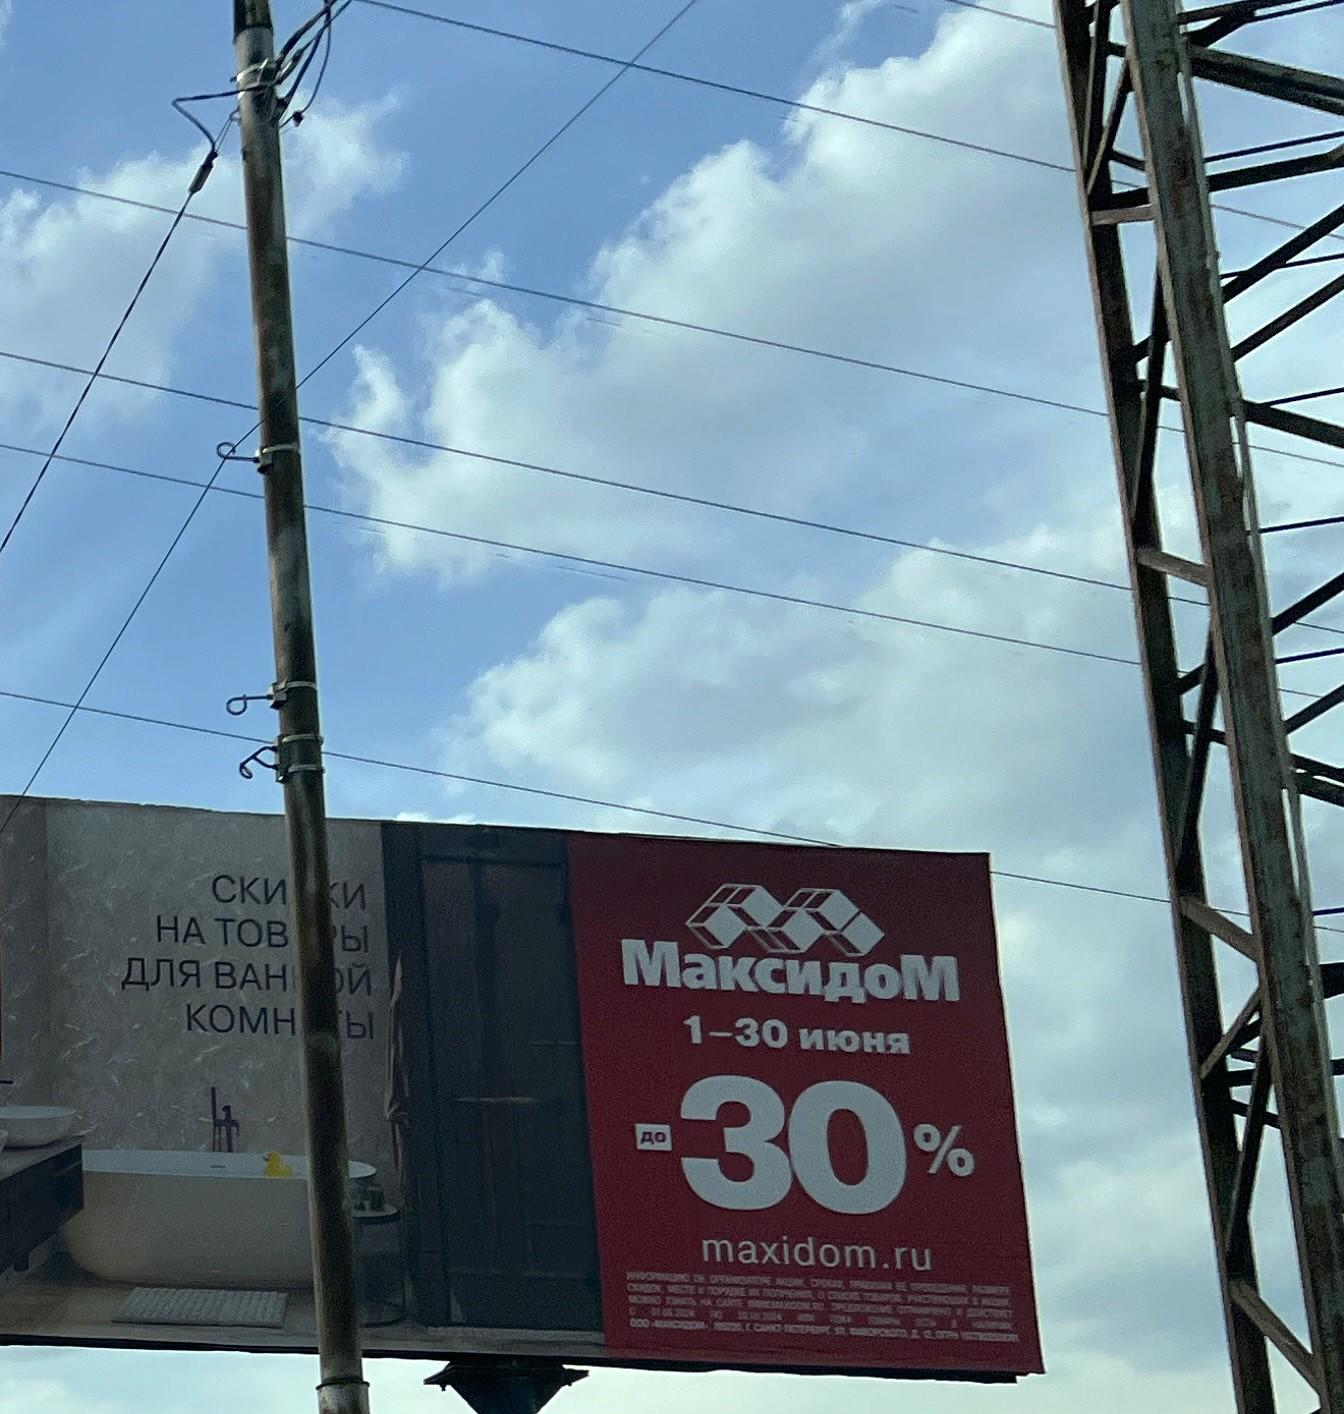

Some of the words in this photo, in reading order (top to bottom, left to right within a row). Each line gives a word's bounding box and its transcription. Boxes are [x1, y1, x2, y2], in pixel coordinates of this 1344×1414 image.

[156, 914, 206, 945] НА
[214, 918, 369, 953] ТОВЫ
[121, 957, 201, 992] ДЛЯ
[186, 1003, 374, 1040] КОМНЫ
[799, 1027, 910, 1055] июня
[639, 1129, 668, 1145] до
[701, 1236, 933, 1272] maxidom.ru
